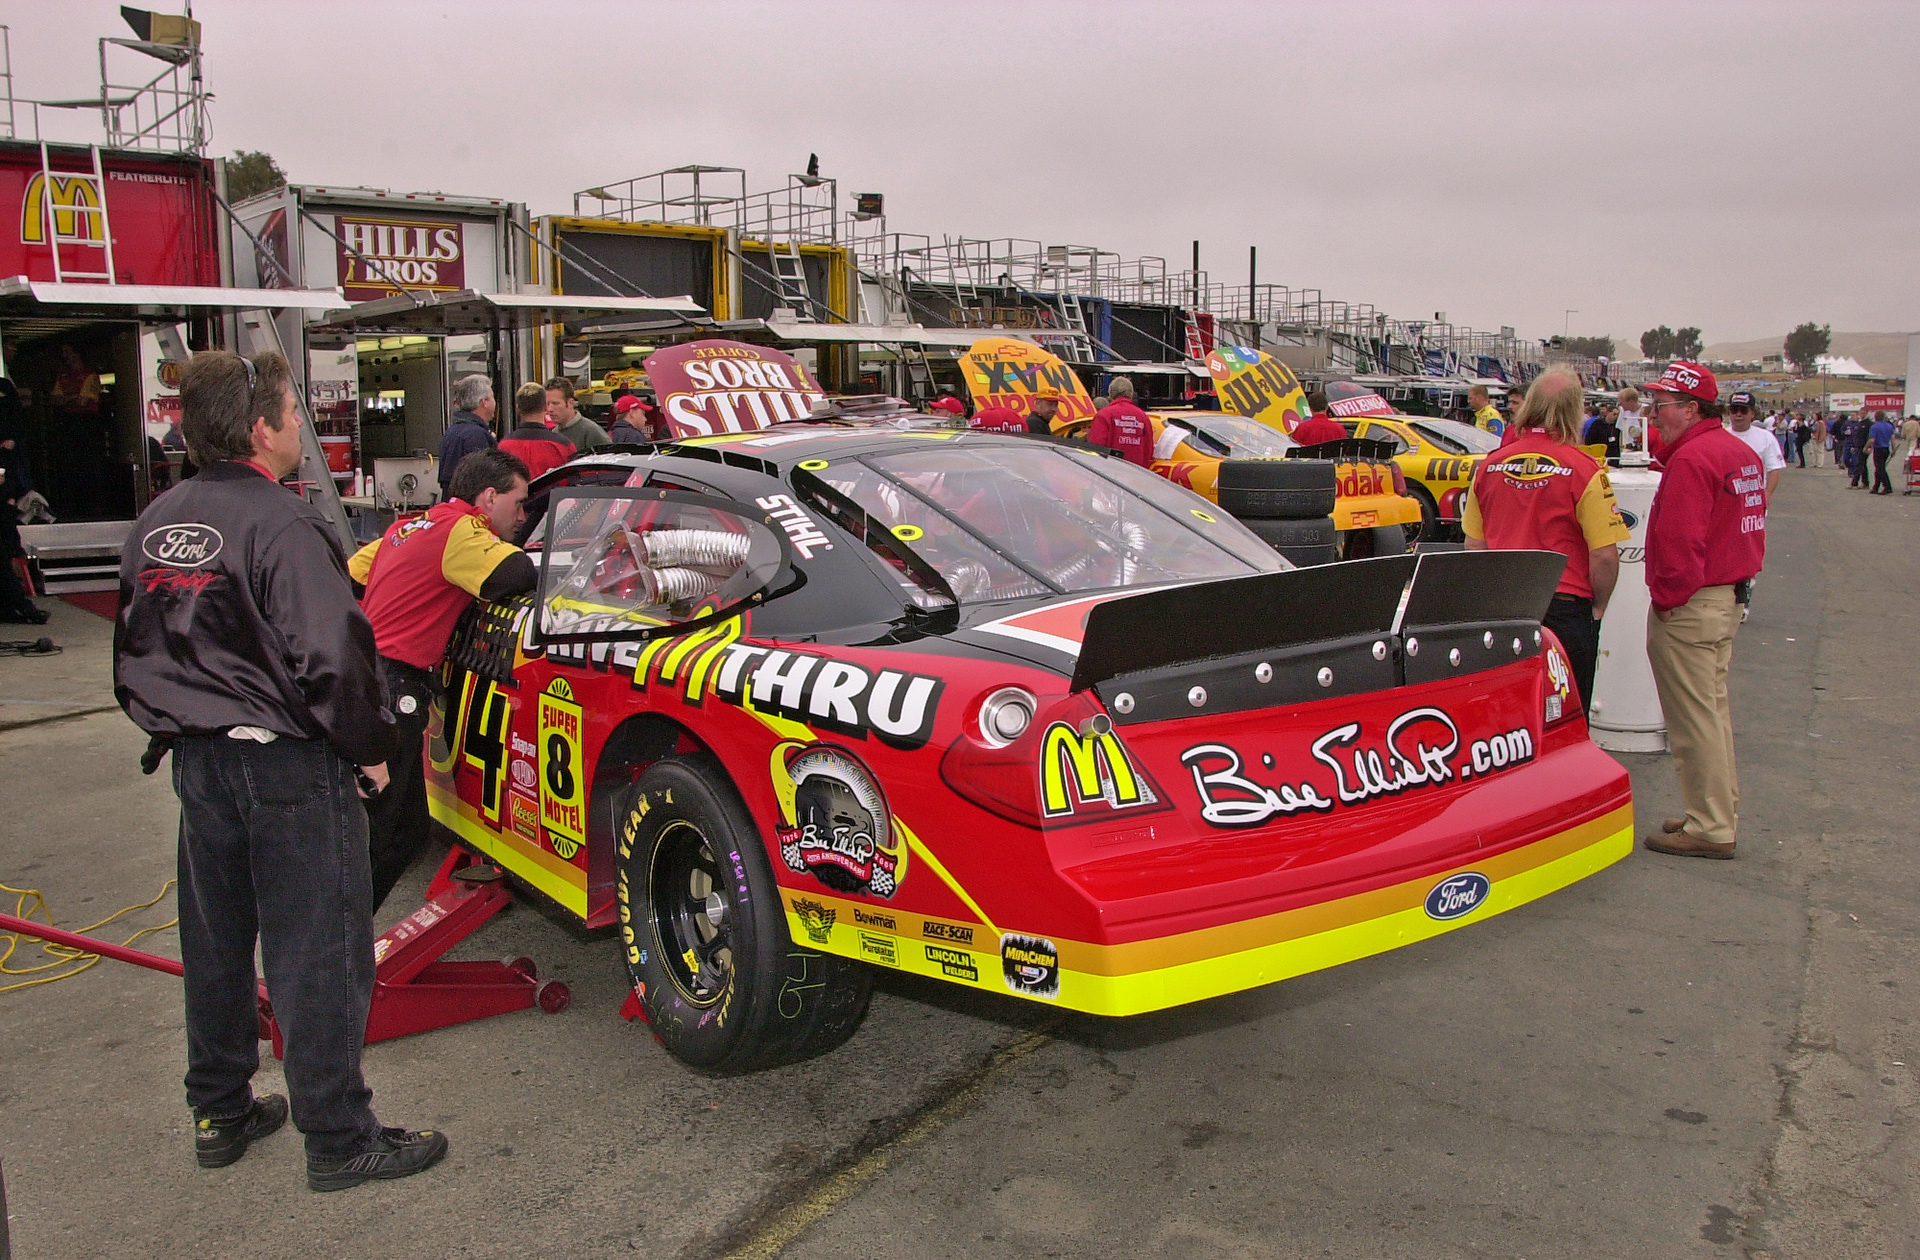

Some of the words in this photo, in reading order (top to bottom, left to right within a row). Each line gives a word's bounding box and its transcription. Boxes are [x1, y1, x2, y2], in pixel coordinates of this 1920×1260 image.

[109, 171, 187, 185] FEATHERLITE
[342, 223, 460, 262] HILLS
[365, 259, 439, 284] BROS
[693, 347, 761, 360] COFFEE
[970, 353, 998, 361] FILM
[683, 358, 796, 390] BROS
[974, 361, 1076, 394] MAX
[1676, 370, 1700, 390] Cup
[1119, 436, 1140, 445] Official
[1486, 463, 1524, 474] DRIVE
[1536, 464, 1573, 476] THRU
[755, 493, 830, 560] STIHL
[158, 529, 209, 560] Ford
[1547, 650, 1570, 693] 94
[718, 643, 935, 737] THRU
[542, 704, 578, 744] SUPER
[546, 733, 575, 800] 8
[1181, 742, 1331, 826] Bill
[543, 788, 583, 835] MOTEL
[1441, 880, 1478, 914] Ford
[853, 908, 897, 931] Bowman
[926, 947, 970, 967] LINCOLN
[1005, 946, 1056, 968] MIRACHEM
